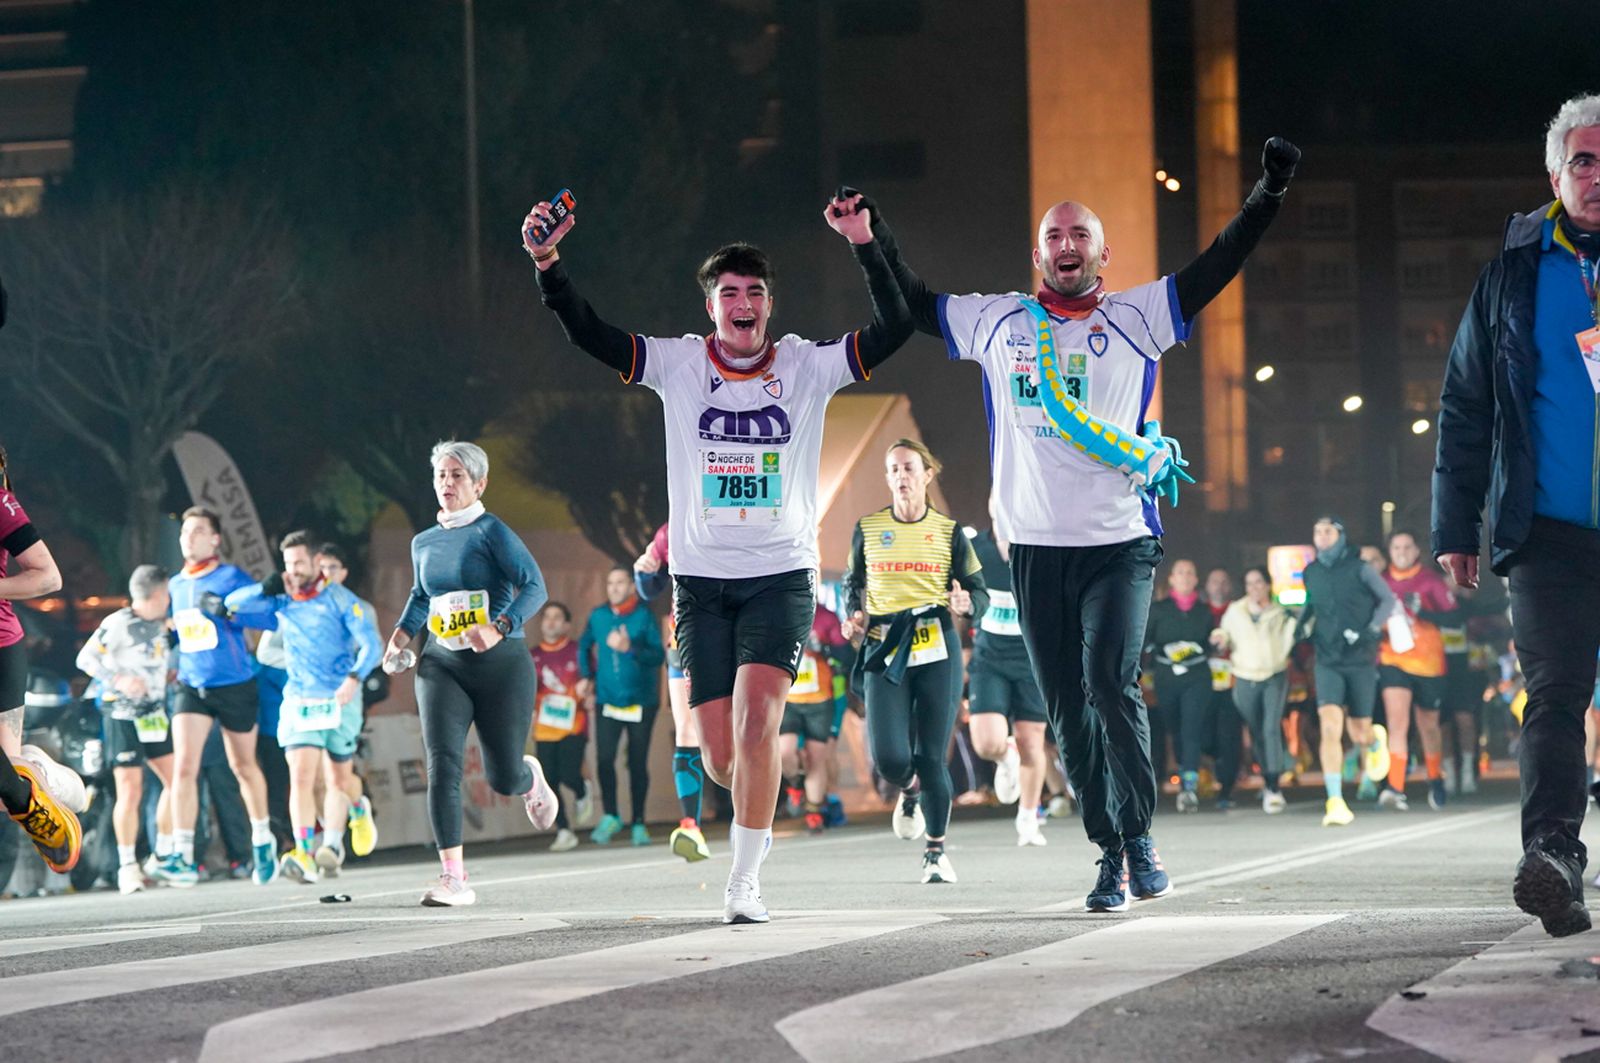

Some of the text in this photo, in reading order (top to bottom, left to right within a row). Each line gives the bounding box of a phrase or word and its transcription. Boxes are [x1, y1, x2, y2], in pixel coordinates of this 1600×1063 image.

[708, 465, 727, 474] SAN
[728, 463, 755, 474] ANTÓN
[717, 456, 755, 464] NOCHE DE
[717, 476, 768, 499] 7851
[440, 610, 478, 633] 344
